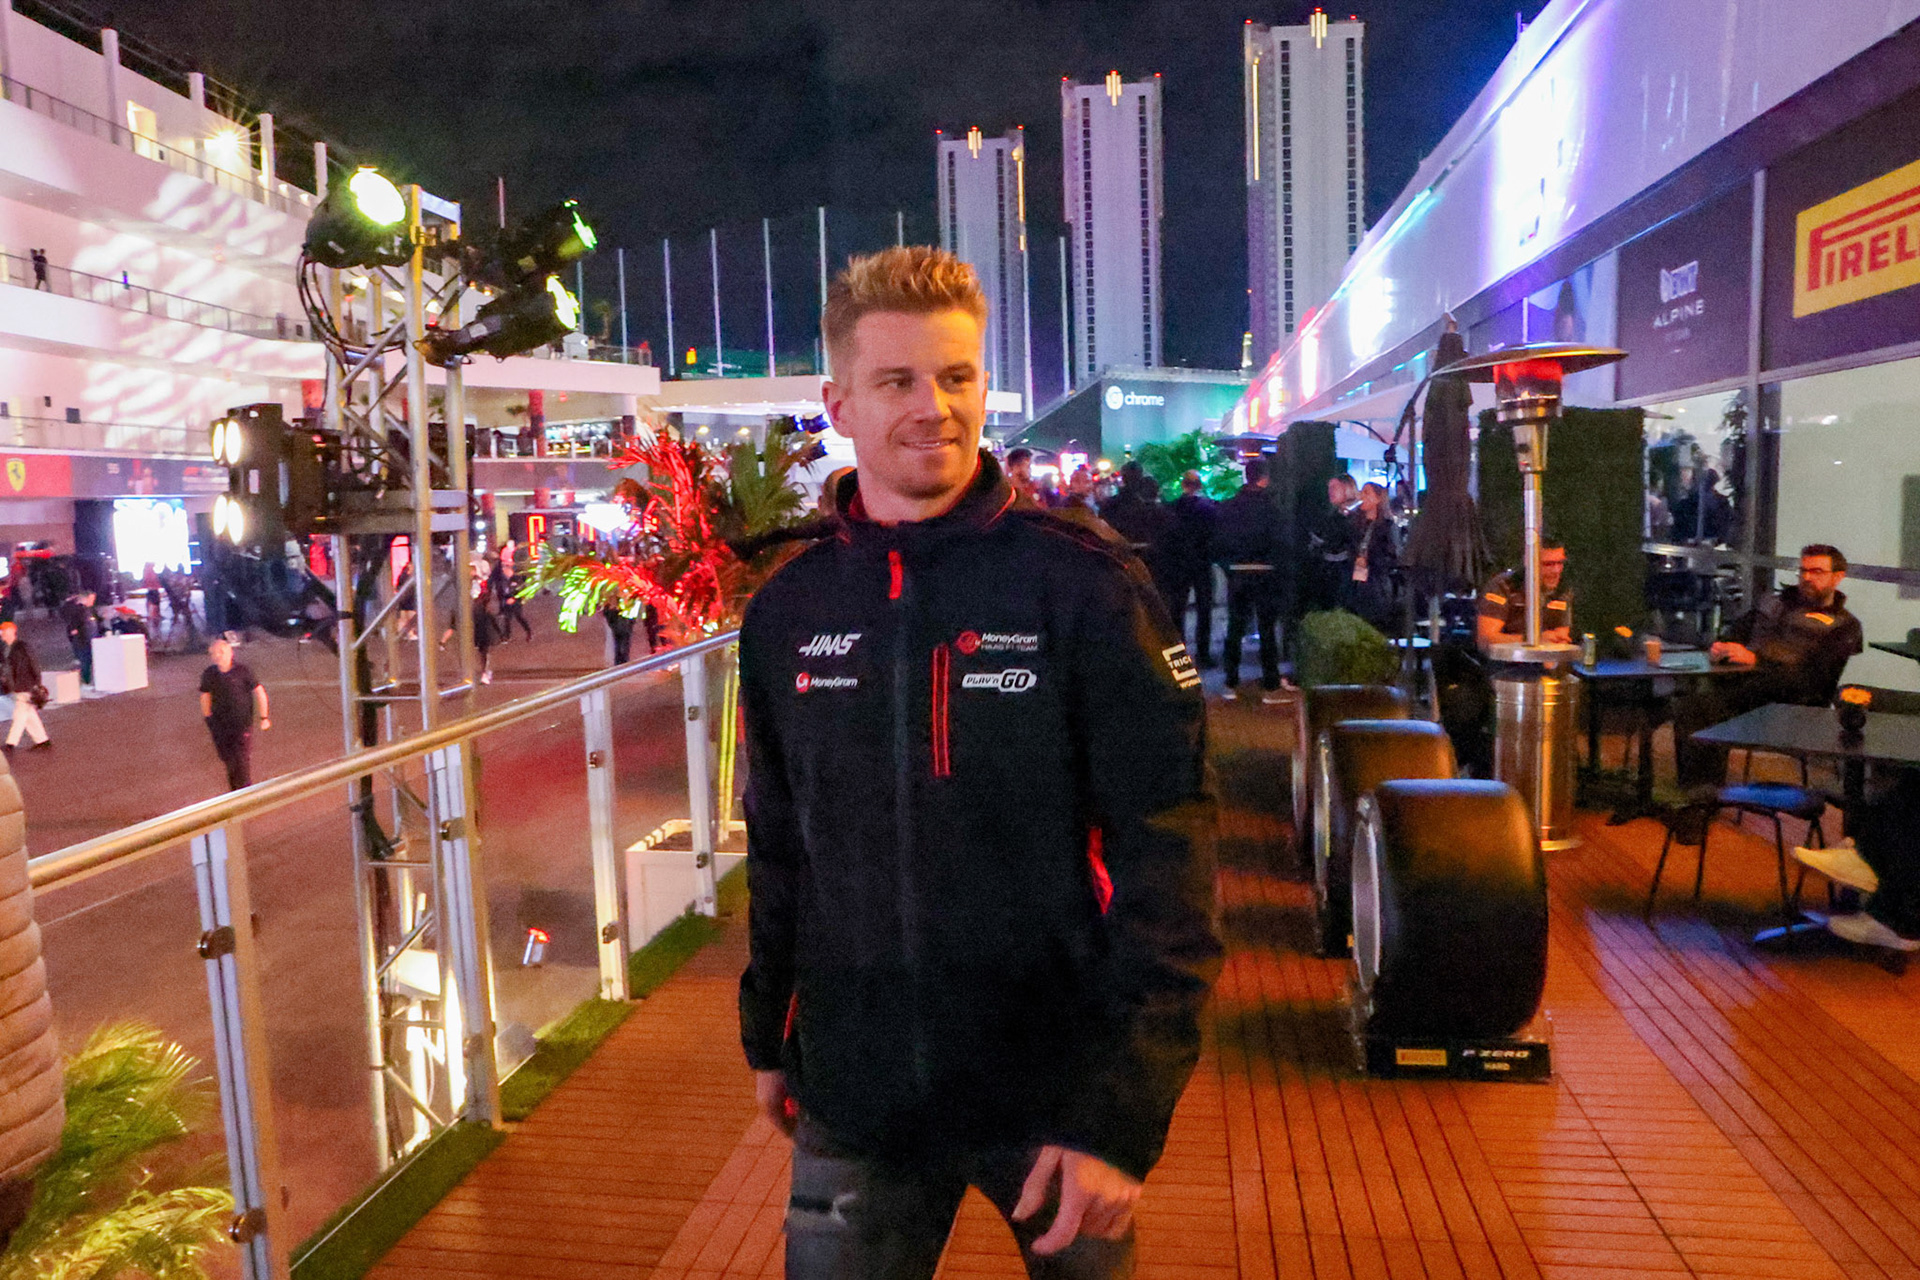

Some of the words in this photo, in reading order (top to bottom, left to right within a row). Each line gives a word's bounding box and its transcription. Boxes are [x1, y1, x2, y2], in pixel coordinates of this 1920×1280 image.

[1806, 184, 1920, 292] PIREL
[1653, 299, 1704, 329] ALPINE
[1124, 391, 1165, 407] chrome
[798, 633, 863, 657] HAAS
[981, 632, 1038, 645] MoneyGram
[1001, 672, 1030, 689] GO
